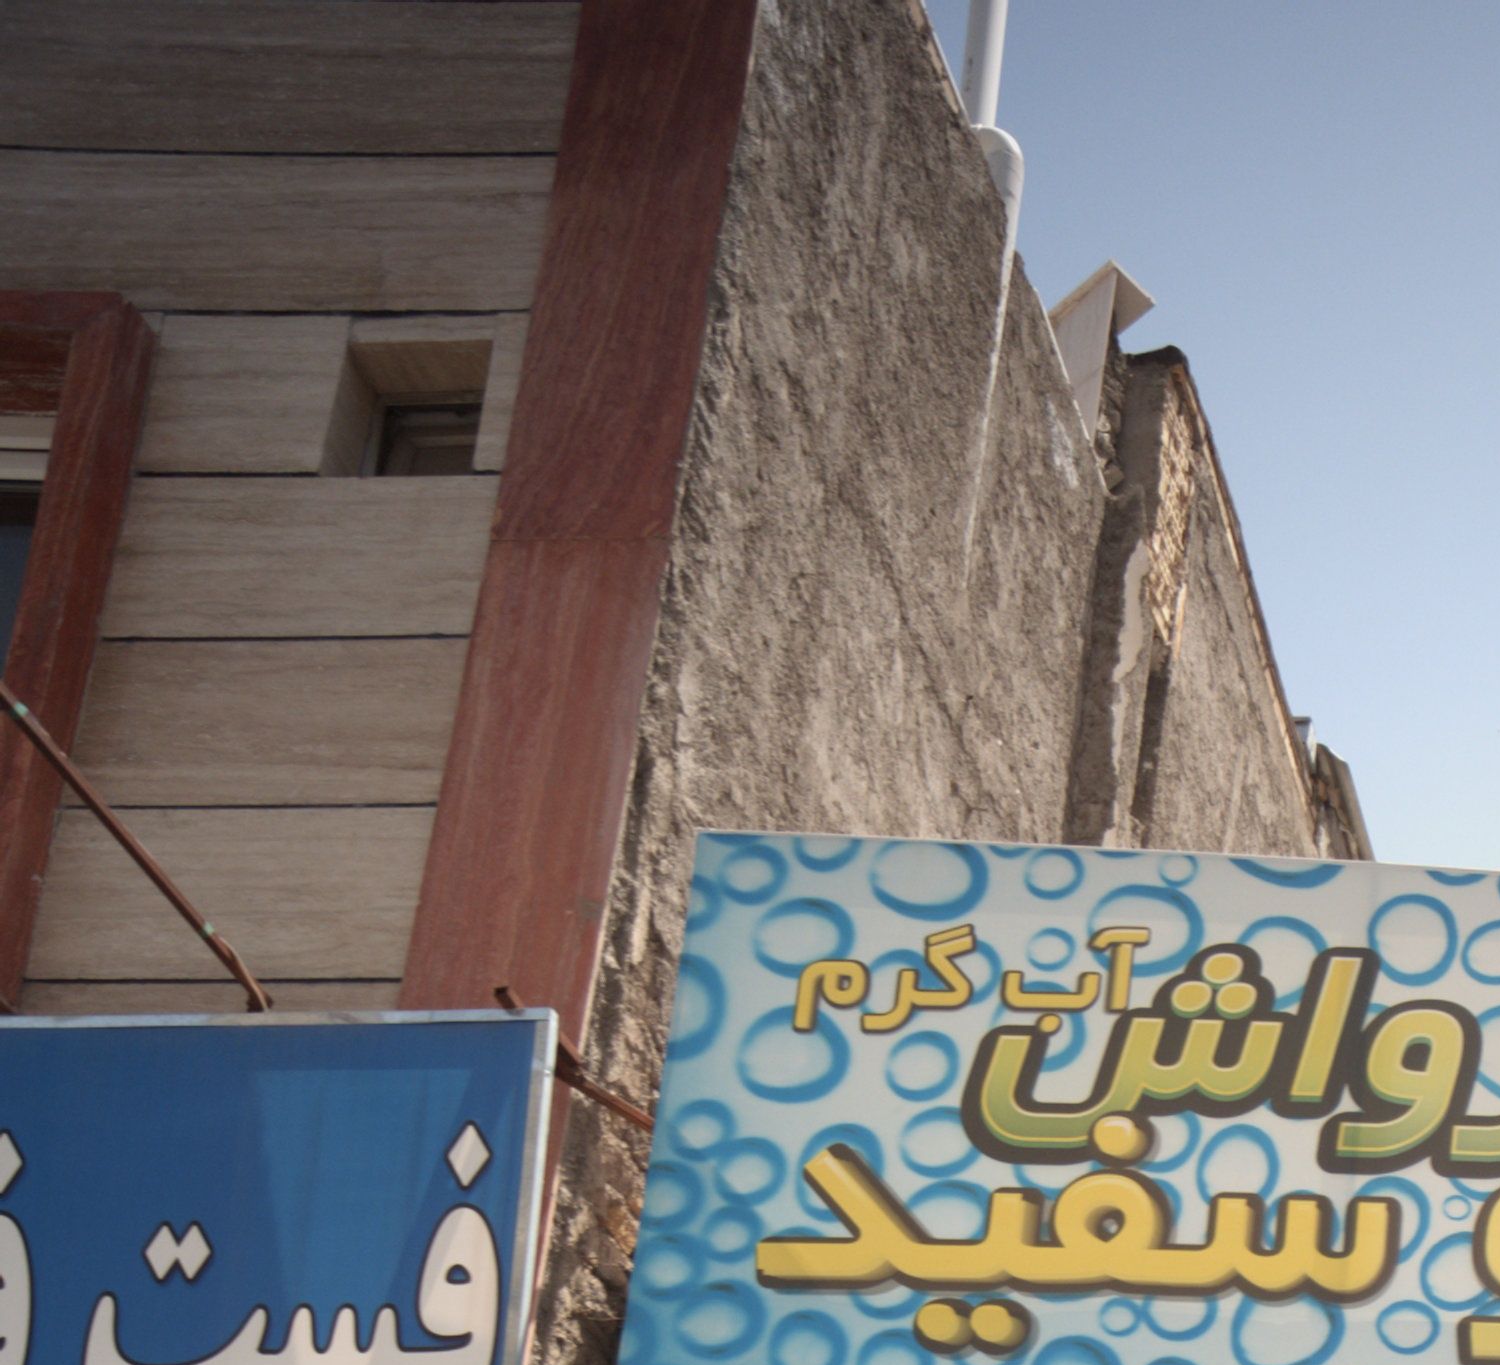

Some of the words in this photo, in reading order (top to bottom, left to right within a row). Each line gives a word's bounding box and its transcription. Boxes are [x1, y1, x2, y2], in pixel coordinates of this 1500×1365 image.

[792, 924, 974, 1033] گرم
[1002, 927, 1151, 1036] آب
[755, 1143, 1400, 1354] سفید
